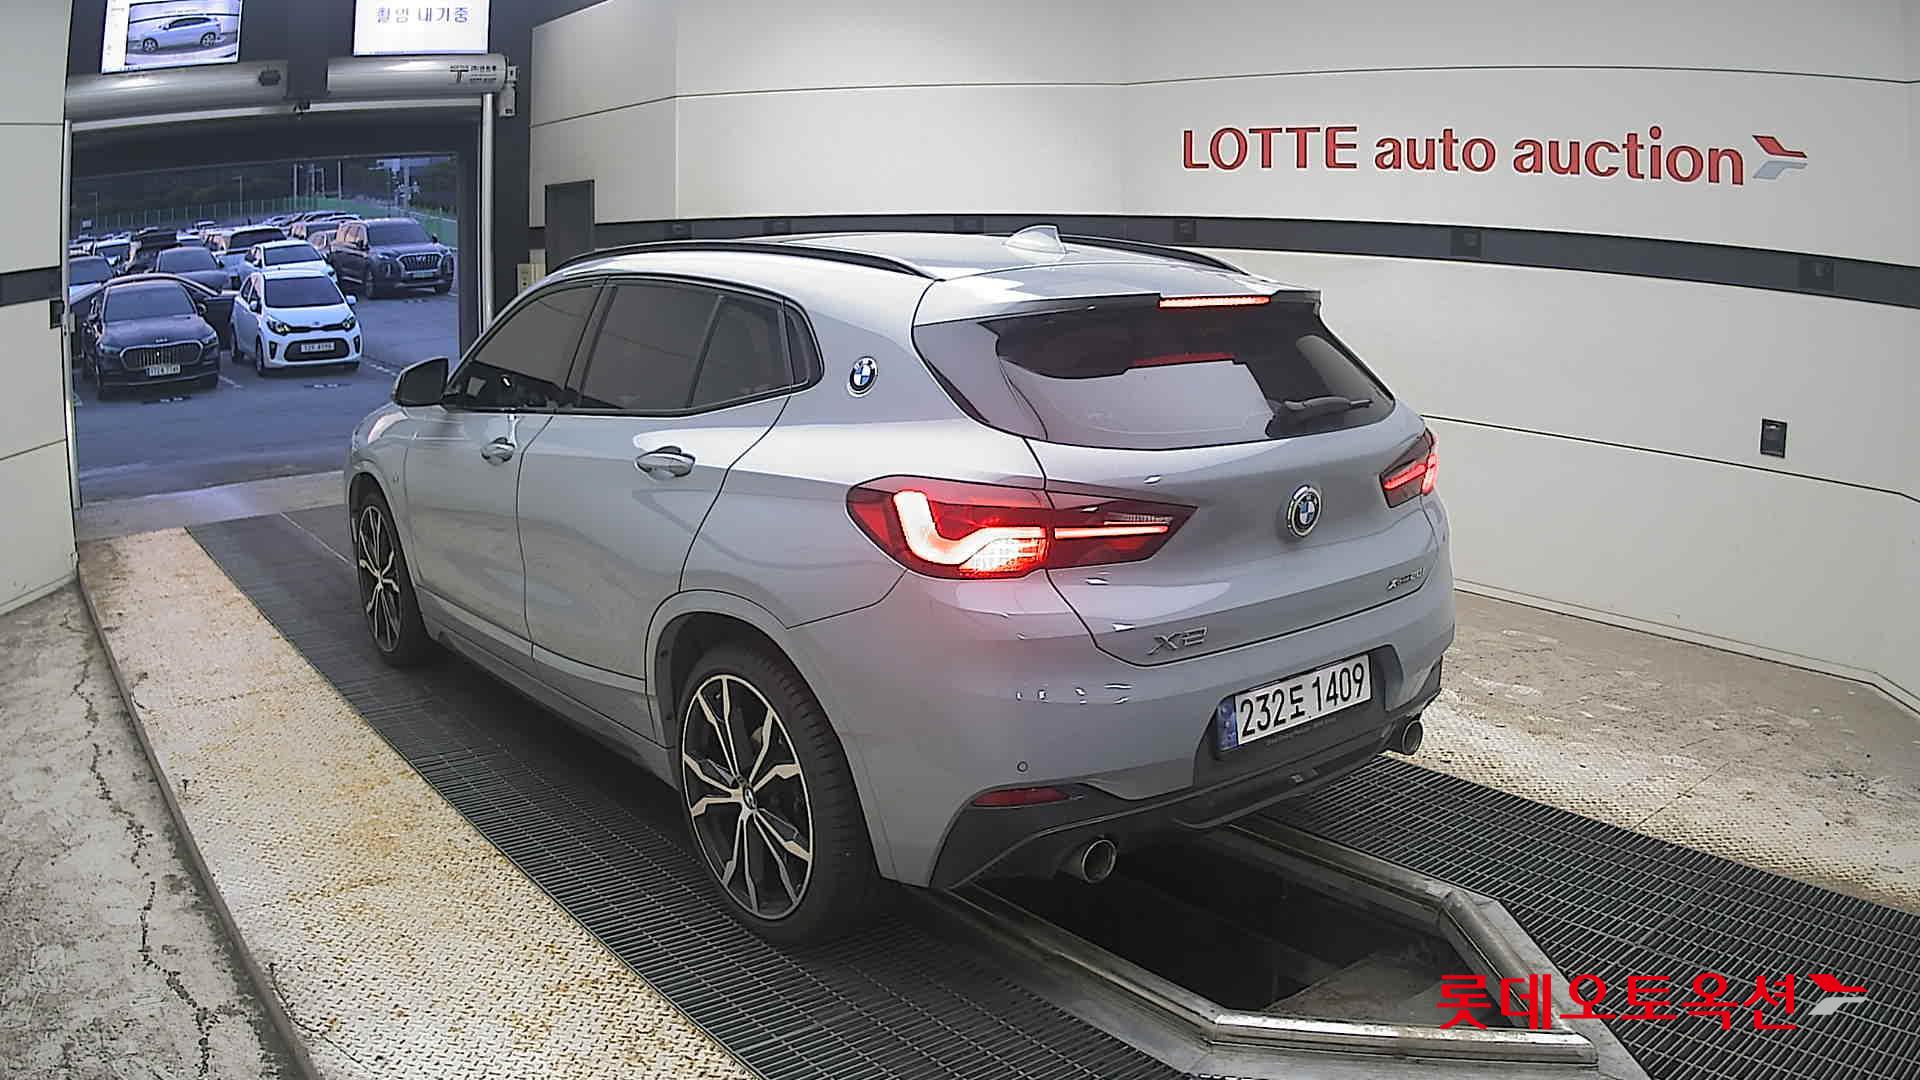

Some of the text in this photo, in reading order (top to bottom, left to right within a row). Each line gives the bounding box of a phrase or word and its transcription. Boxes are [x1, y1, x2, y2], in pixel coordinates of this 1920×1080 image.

[1183, 126, 1744, 186] LOTTE auto auction
[1147, 626, 1207, 655] X2
[1312, 663, 1364, 712] 1409
